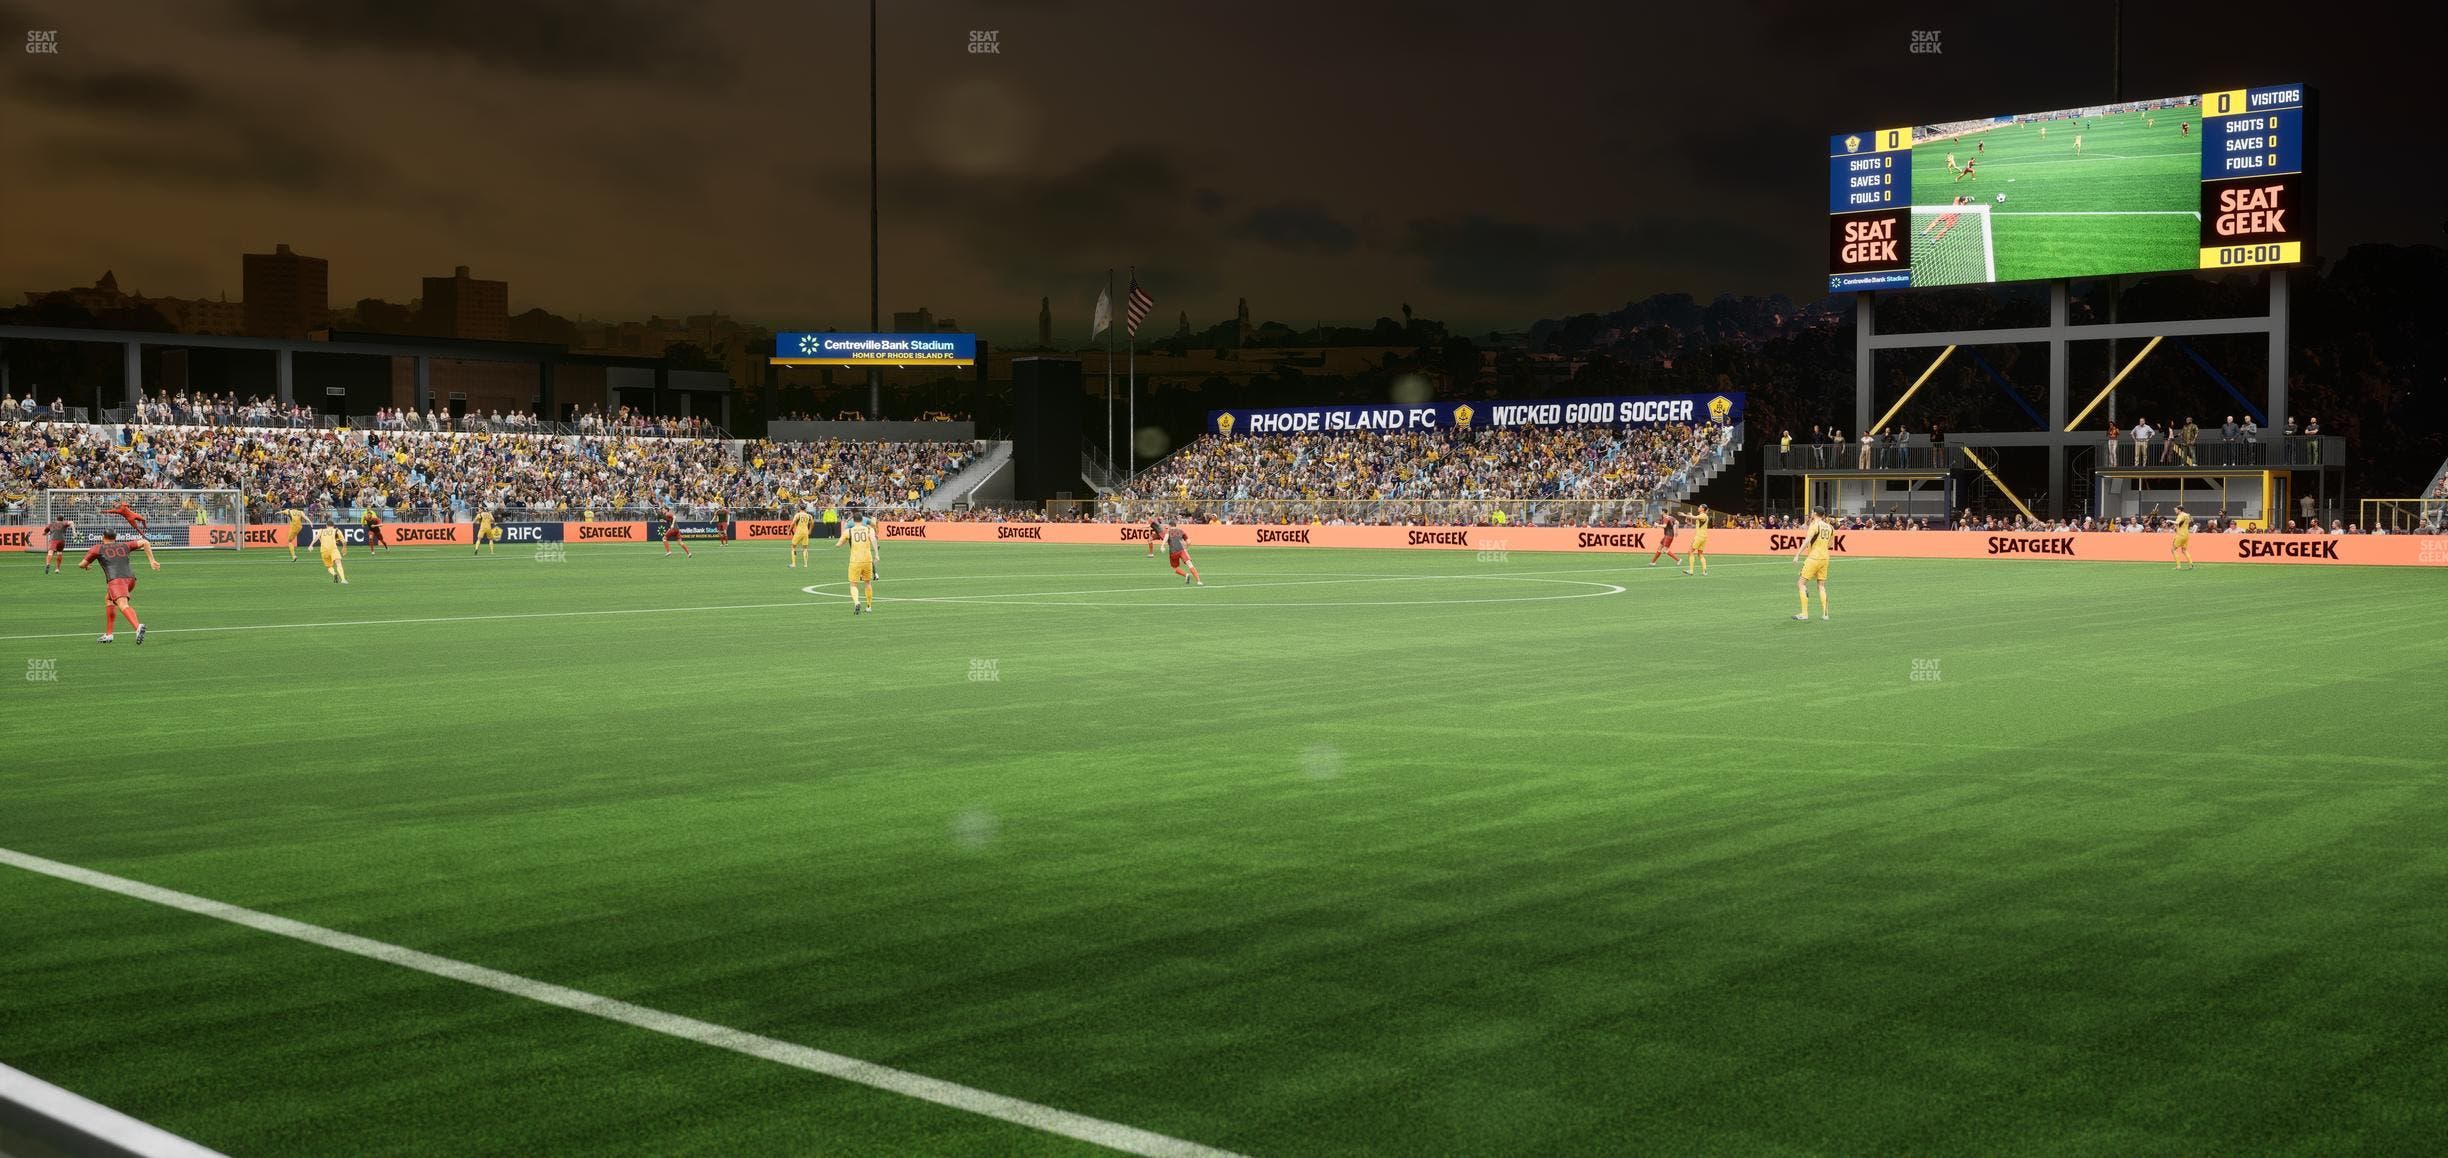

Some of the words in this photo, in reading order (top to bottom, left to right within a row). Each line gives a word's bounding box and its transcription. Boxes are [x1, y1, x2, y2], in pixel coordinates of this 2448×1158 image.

[2218, 93, 2230, 113] 0
[2251, 90, 2300, 106] VISITORS
[2226, 119, 2264, 133] SHOTS
[2269, 116, 2278, 129] 0
[1889, 130, 1899, 149] 0
[2226, 137, 2263, 151] SAVES
[2269, 135, 2277, 148] 0
[1850, 158, 1880, 171] SHOTS
[1884, 157, 1892, 168] 0
[2226, 156, 2263, 170] FOULS
[2268, 153, 2276, 166] 0
[1850, 175, 1880, 187] SAVES
[1884, 173, 1892, 185] 0
[1850, 191, 1880, 204] FOULS
[1884, 190, 1892, 201] 0
[2220, 185, 2284, 212] SEAT
[1845, 218, 1896, 242] SEAT
[2216, 209, 2286, 236] GEEK
[1842, 240, 1898, 263] GEEK
[2220, 244, 2280, 265] 00:00
[910, 340, 954, 350] Stadium
[1250, 413, 1320, 432] RHODE
[1325, 410, 1404, 430] ISLAND
[1409, 408, 1436, 428] FC
[1492, 405, 1561, 426] WICKED
[1565, 402, 1614, 423] GOOD
[1620, 400, 1694, 422] SOCCER
[396, 528, 456, 542] SEATGEEK
[507, 526, 542, 540] RIFC
[579, 526, 632, 540] SEATGEEK
[854, 532, 867, 542] 00
[886, 525, 926, 538] SEATGEEK
[998, 526, 1041, 540] SEATGEEK
[1256, 528, 1310, 544] SEATGEEK
[1408, 530, 1468, 546] SEATGEEK
[1578, 532, 1645, 549] SEATGEEK
[1988, 536, 2075, 556] SEATGEEK
[2238, 538, 2339, 560] SEATGEEK
